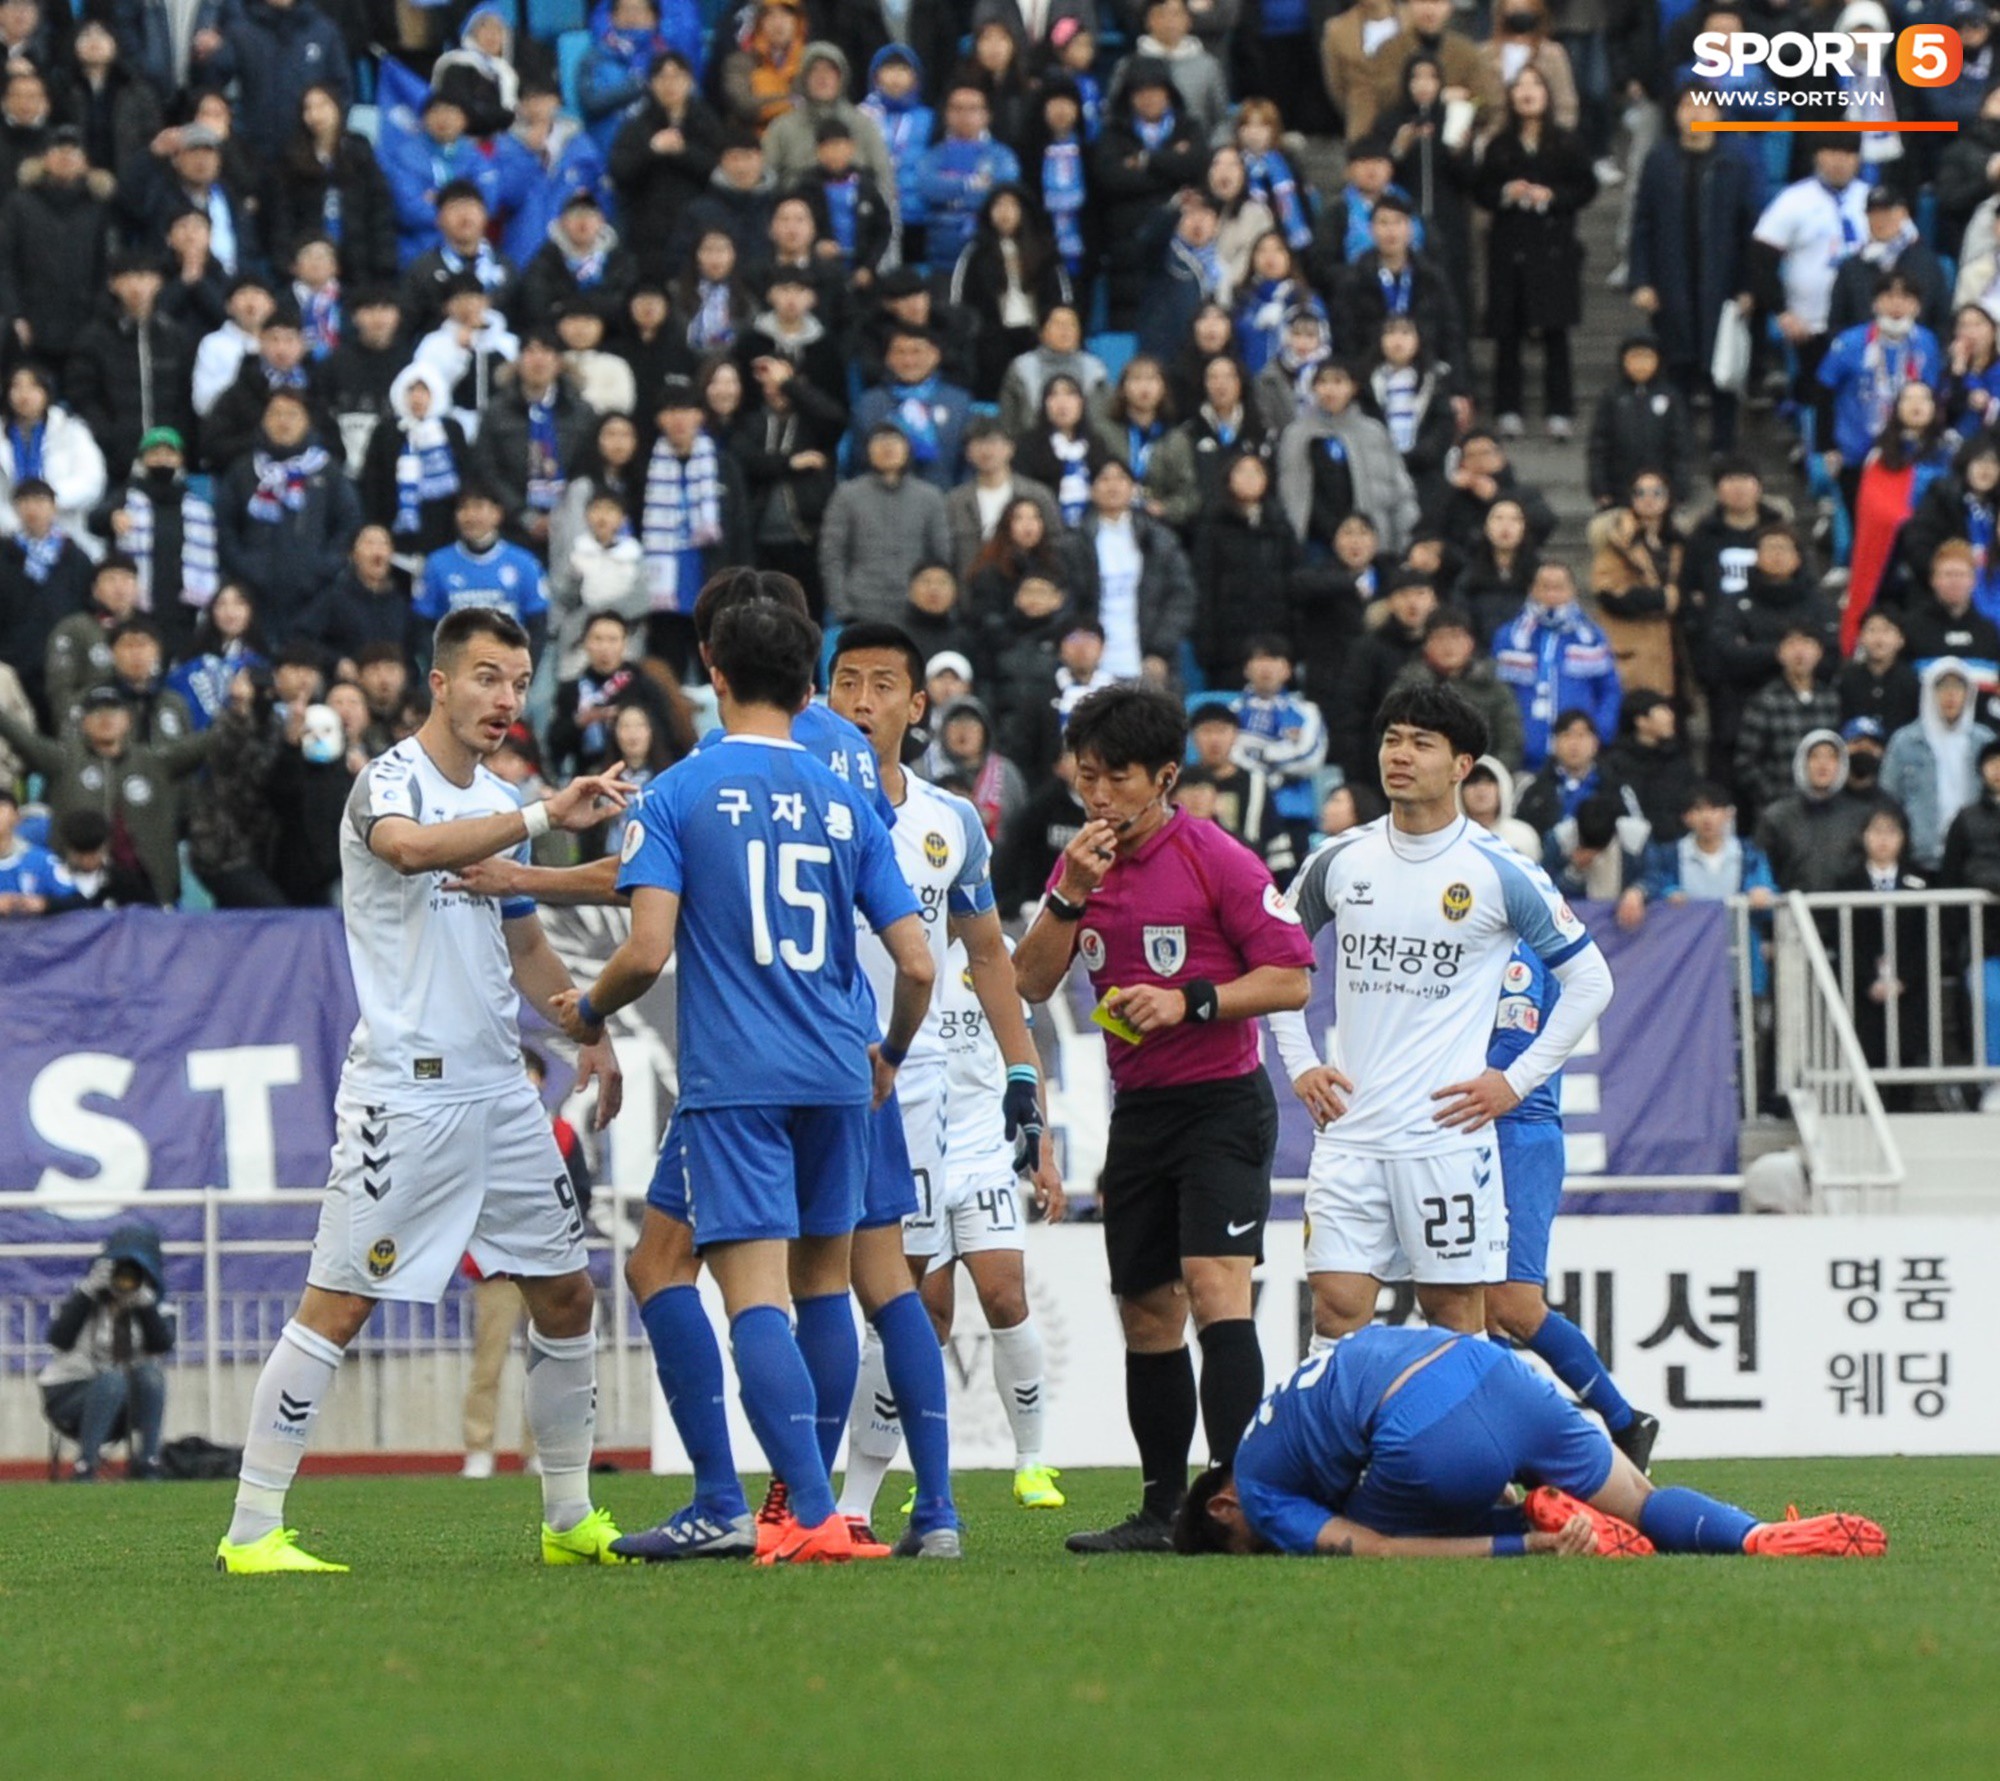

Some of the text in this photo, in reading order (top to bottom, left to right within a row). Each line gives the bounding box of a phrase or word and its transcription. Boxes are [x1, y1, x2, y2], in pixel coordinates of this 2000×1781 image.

[747, 839, 831, 972] 15
[1341, 933, 1465, 978] 인천공항
[976, 1188, 1017, 1224] 47
[1423, 1193, 1476, 1248] 23
[1830, 1257, 1952, 1323] 명품
[1829, 1352, 1948, 1417] 웨딩
